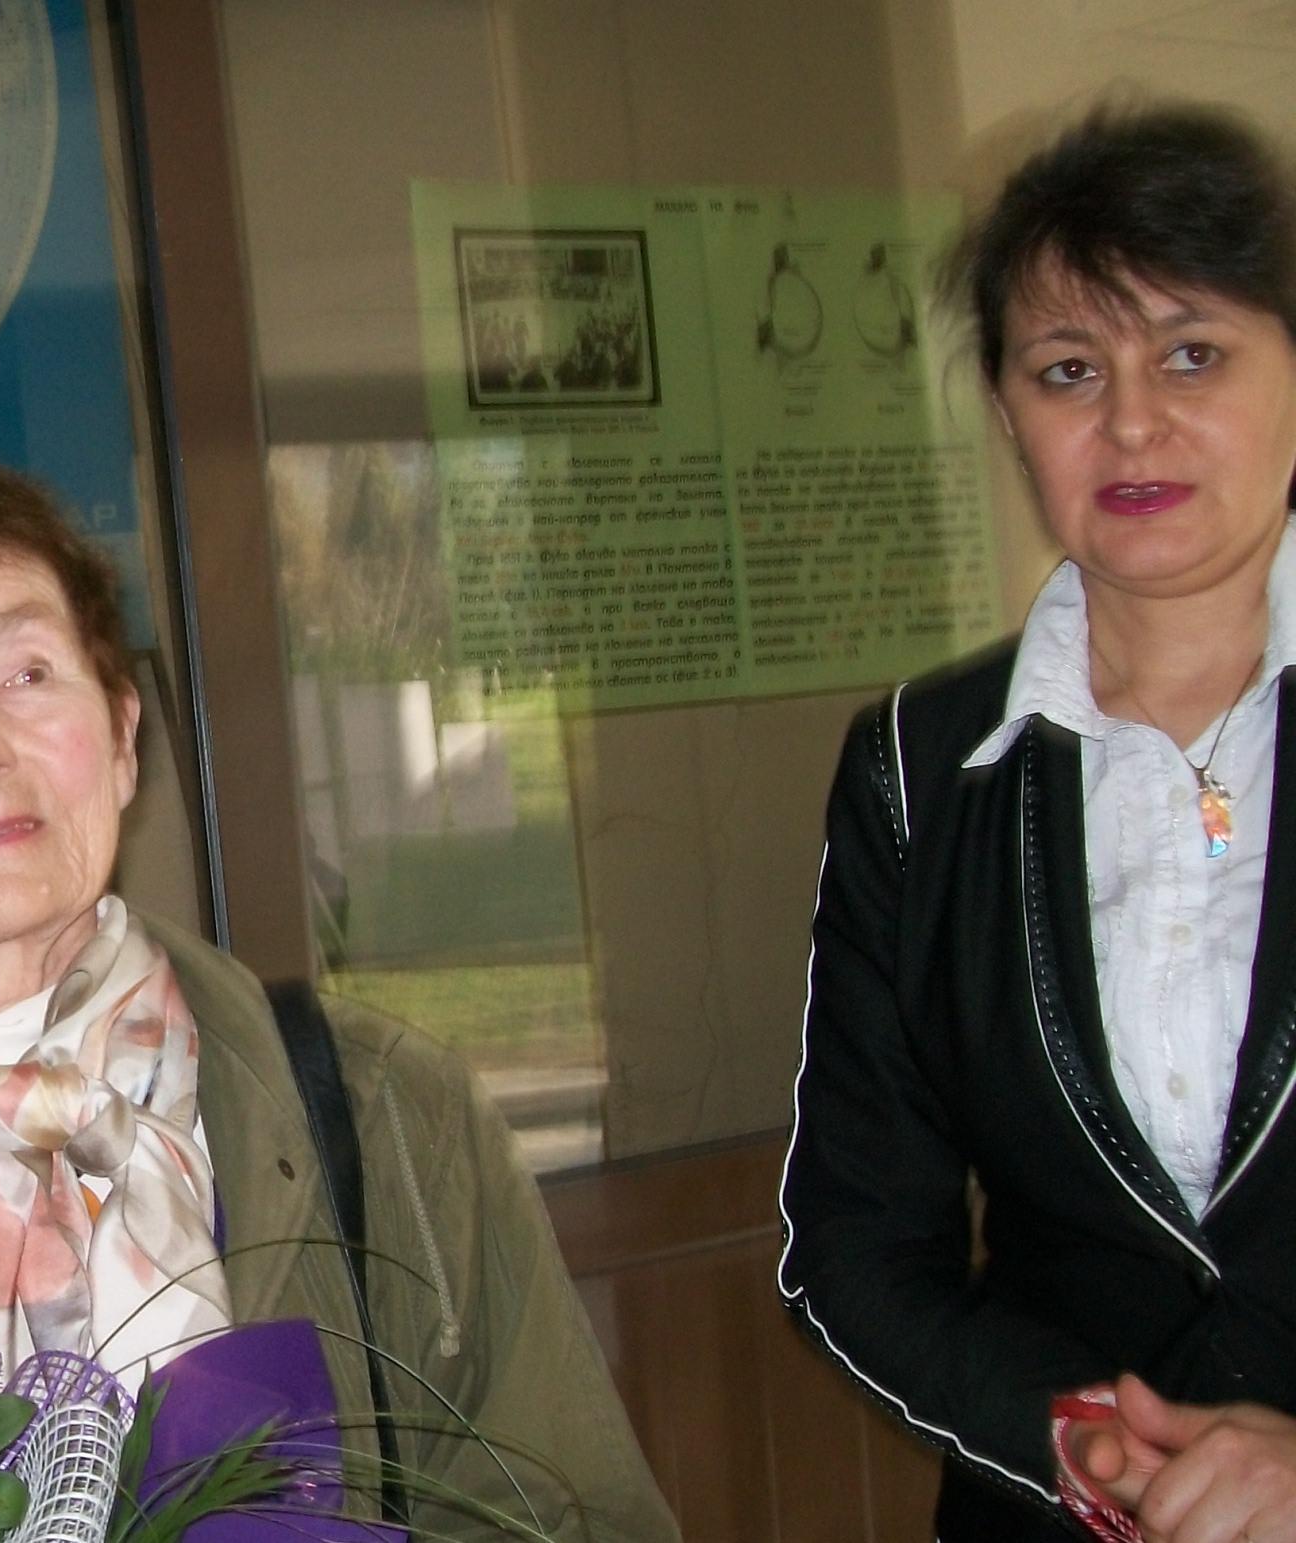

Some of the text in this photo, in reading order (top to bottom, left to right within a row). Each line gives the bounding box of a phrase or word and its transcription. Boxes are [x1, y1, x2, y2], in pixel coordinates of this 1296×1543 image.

[649, 492, 663, 503] на
[533, 510, 601, 527] най-напред
[610, 511, 628, 522] от
[635, 507, 691, 524] френския
[540, 548, 570, 564] Фуко
[576, 546, 616, 560] окачва
[680, 542, 719, 556] топка
[724, 544, 732, 554] с
[542, 566, 579, 580] нишка
[583, 566, 616, 581] дълга
[646, 563, 653, 575] в
[658, 560, 720, 574] Пантеона
[724, 559, 733, 571] в
[546, 583, 606, 601] Периодът
[612, 584, 626, 595] на
[683, 581, 697, 591] на
[702, 577, 733, 590] това
[602, 604, 623, 617] при
[633, 599, 667, 613] всяко
[677, 596, 735, 614] следващо
[532, 622, 594, 637] отклонява
[600, 623, 614, 633] на
[657, 616, 683, 630] Това
[586, 641, 599, 652] на
[659, 637, 673, 648] на
[679, 633, 739, 646] махалото
[607, 673, 653, 688] своята
[656, 674, 669, 685] ос
